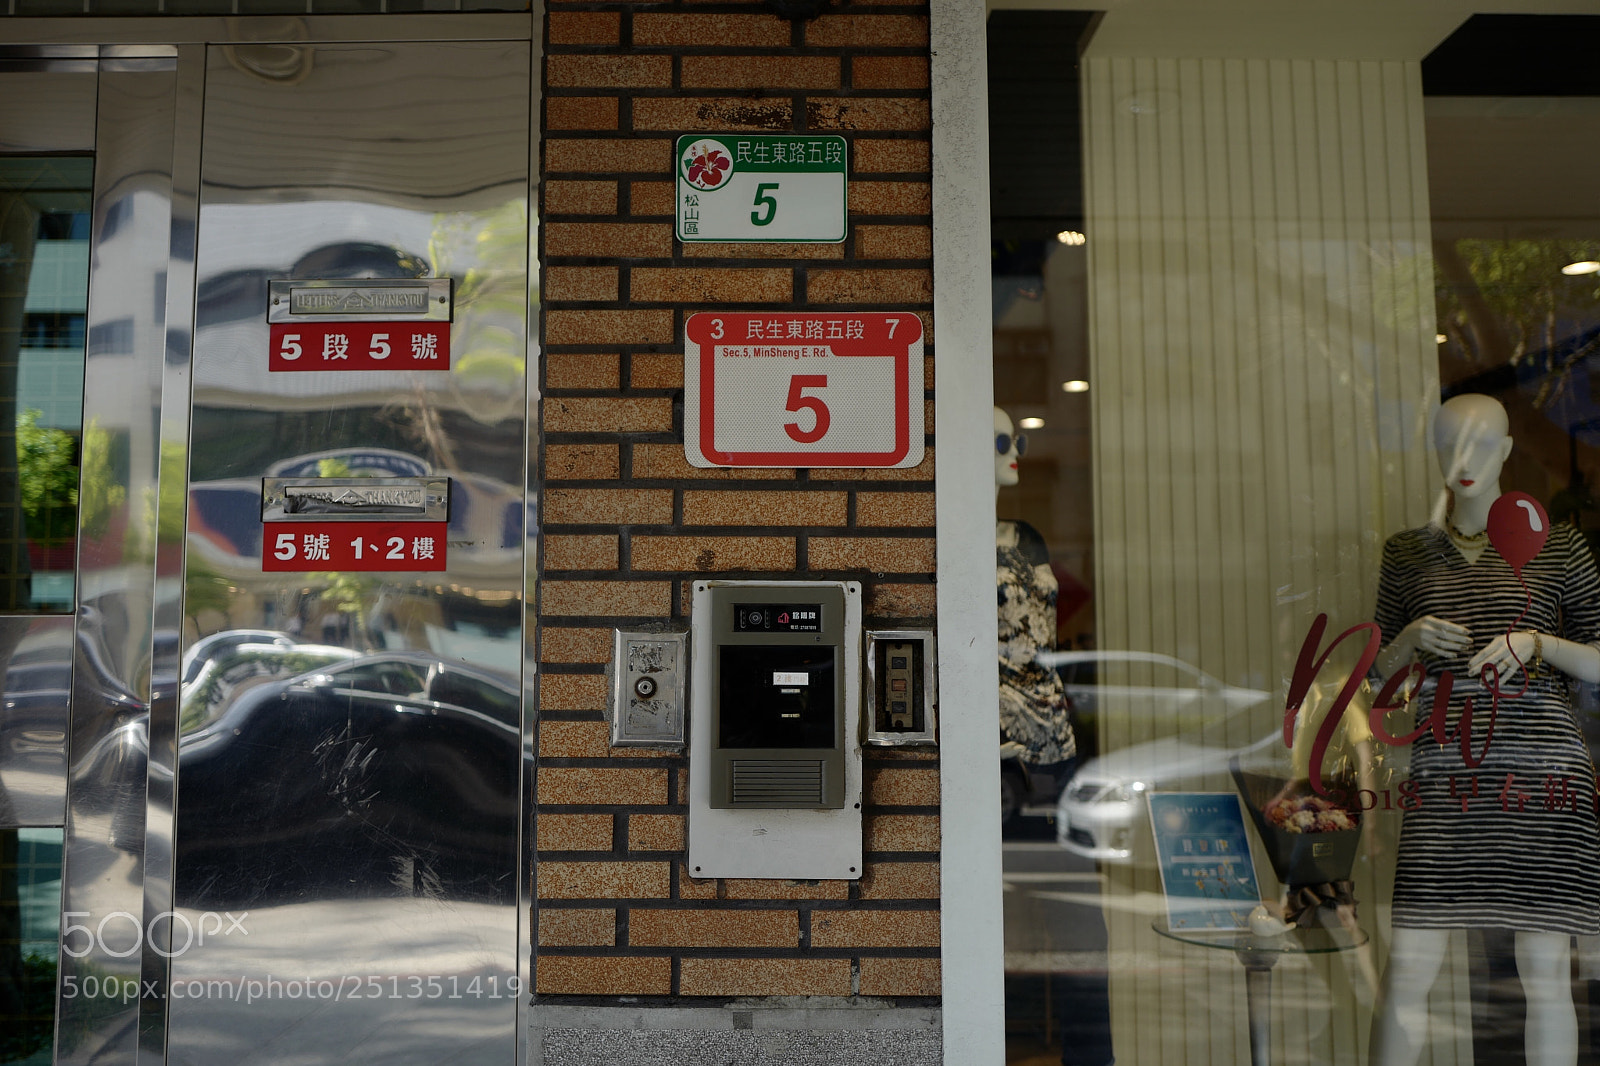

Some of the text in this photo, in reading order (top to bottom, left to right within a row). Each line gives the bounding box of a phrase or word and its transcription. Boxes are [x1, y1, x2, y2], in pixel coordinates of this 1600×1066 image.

[735, 141, 842, 164] 民生東路五段
[684, 194, 699, 235] 松山區
[750, 183, 780, 227] 5
[710, 318, 900, 340] 3 民生東路五段 7
[753, 347, 800, 360] MinSheng
[801, 347, 811, 358] E.
[813, 347, 829, 358] Rd.
[783, 374, 831, 444] 5
[1329, 773, 1600, 813] 2018 早春新
